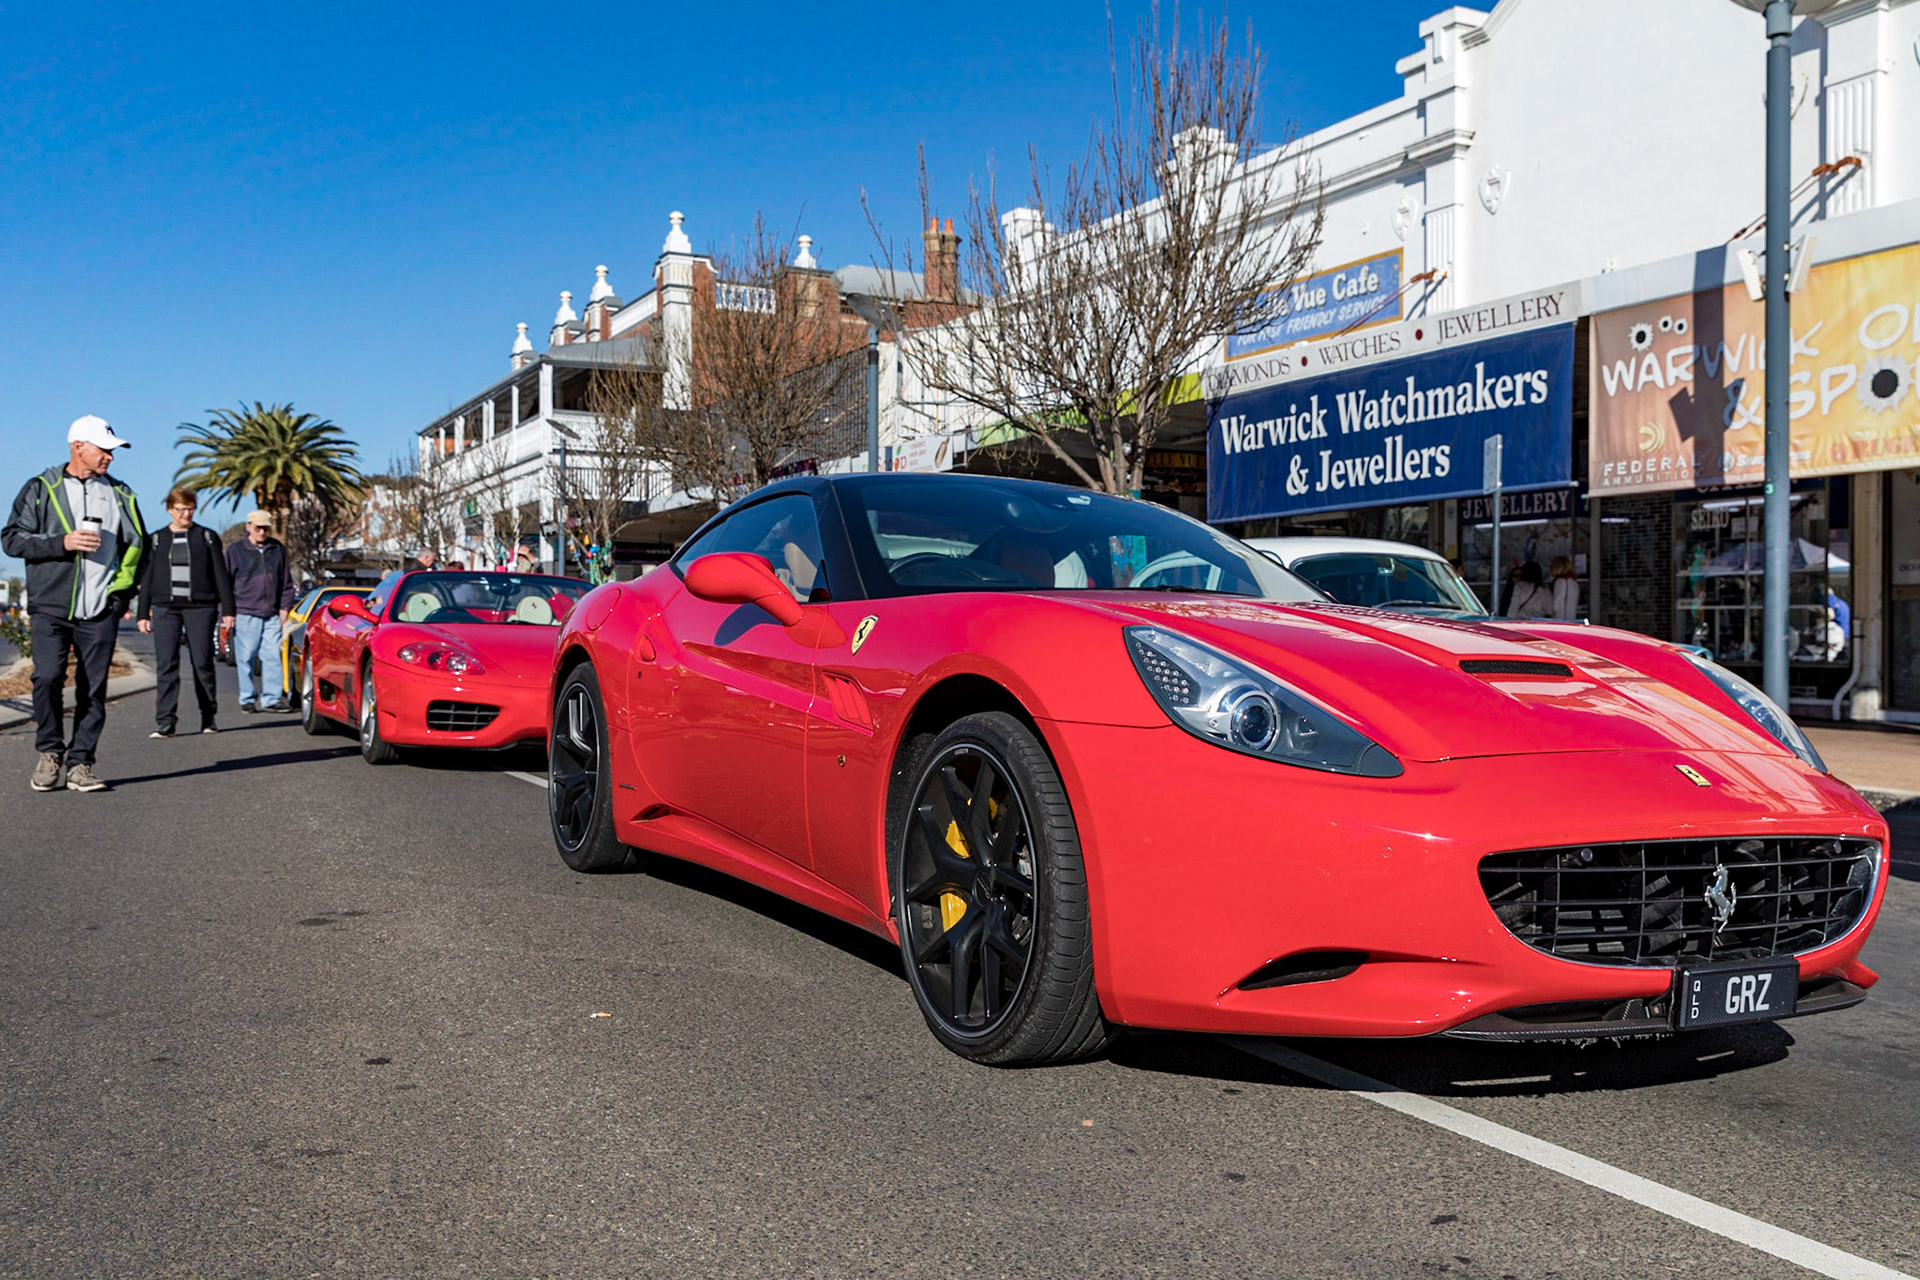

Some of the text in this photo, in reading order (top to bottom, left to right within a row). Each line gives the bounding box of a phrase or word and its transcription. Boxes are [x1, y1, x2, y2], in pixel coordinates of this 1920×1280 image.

[1291, 284, 1327, 312] Vue
[1332, 265, 1380, 301] Cafe
[1286, 309, 1337, 335] FRIENDLY
[1319, 331, 1401, 365] WATCHES
[1437, 291, 1565, 345] JEWELLERY
[1219, 361, 1548, 456] Warwick Watchmakers
[1723, 378, 1763, 430] &
[1285, 435, 1451, 496] & Jewellers
[1603, 454, 1701, 476] FEDERAL
[1463, 490, 1569, 519] JEWELLERY
[1765, 484, 1774, 494] 3
[1691, 508, 1729, 530] SEIKO
[1691, 980, 1701, 1019] QLD
[1725, 973, 1772, 1014] GRZ
